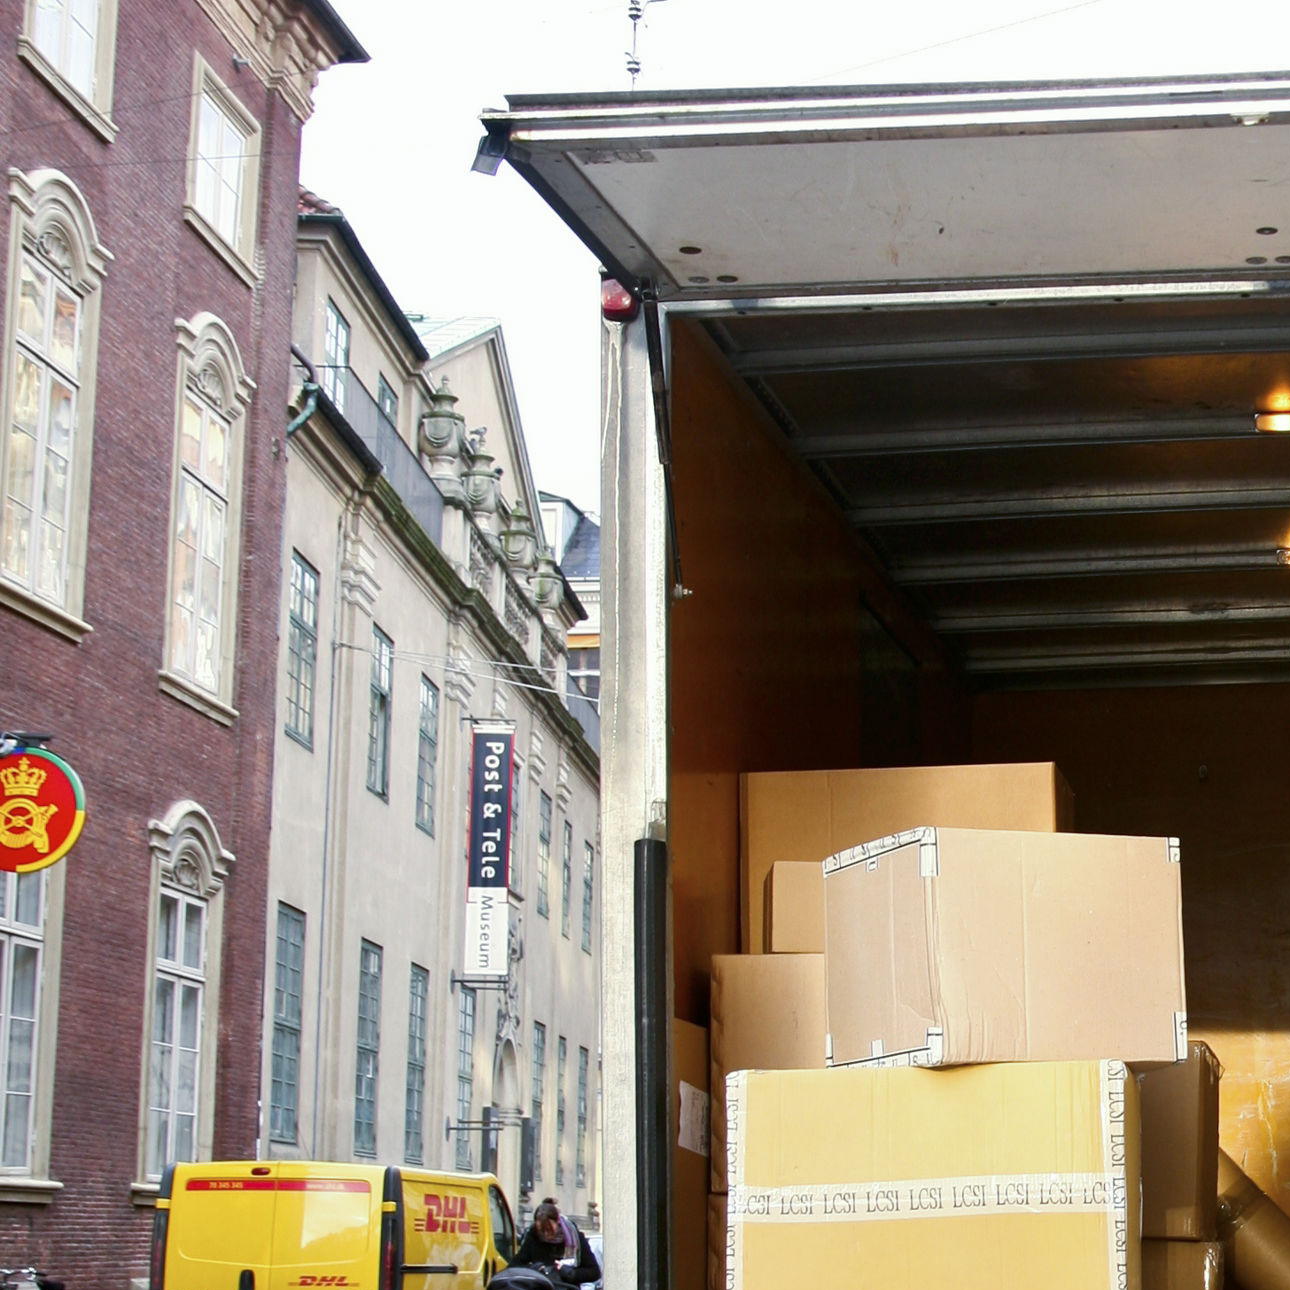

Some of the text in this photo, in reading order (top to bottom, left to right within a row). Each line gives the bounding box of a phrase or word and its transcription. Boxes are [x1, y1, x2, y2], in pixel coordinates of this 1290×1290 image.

[479, 741, 505, 968] Post & Tele Museum
[1107, 1059, 1124, 1081] CSI
[423, 1193, 471, 1234] DHL
[780, 1193, 813, 1215] LCSI
[823, 1192, 856, 1214] LCSI
[866, 1190, 900, 1212] LCSI
[909, 1187, 943, 1210] LCSI
[953, 1184, 986, 1208] LCSI
[996, 1183, 1029, 1206] LCSI
[1040, 1182, 1073, 1205] LCSI
[1083, 1181, 1109, 1205] LCS
[298, 1276, 350, 1287] DHL
